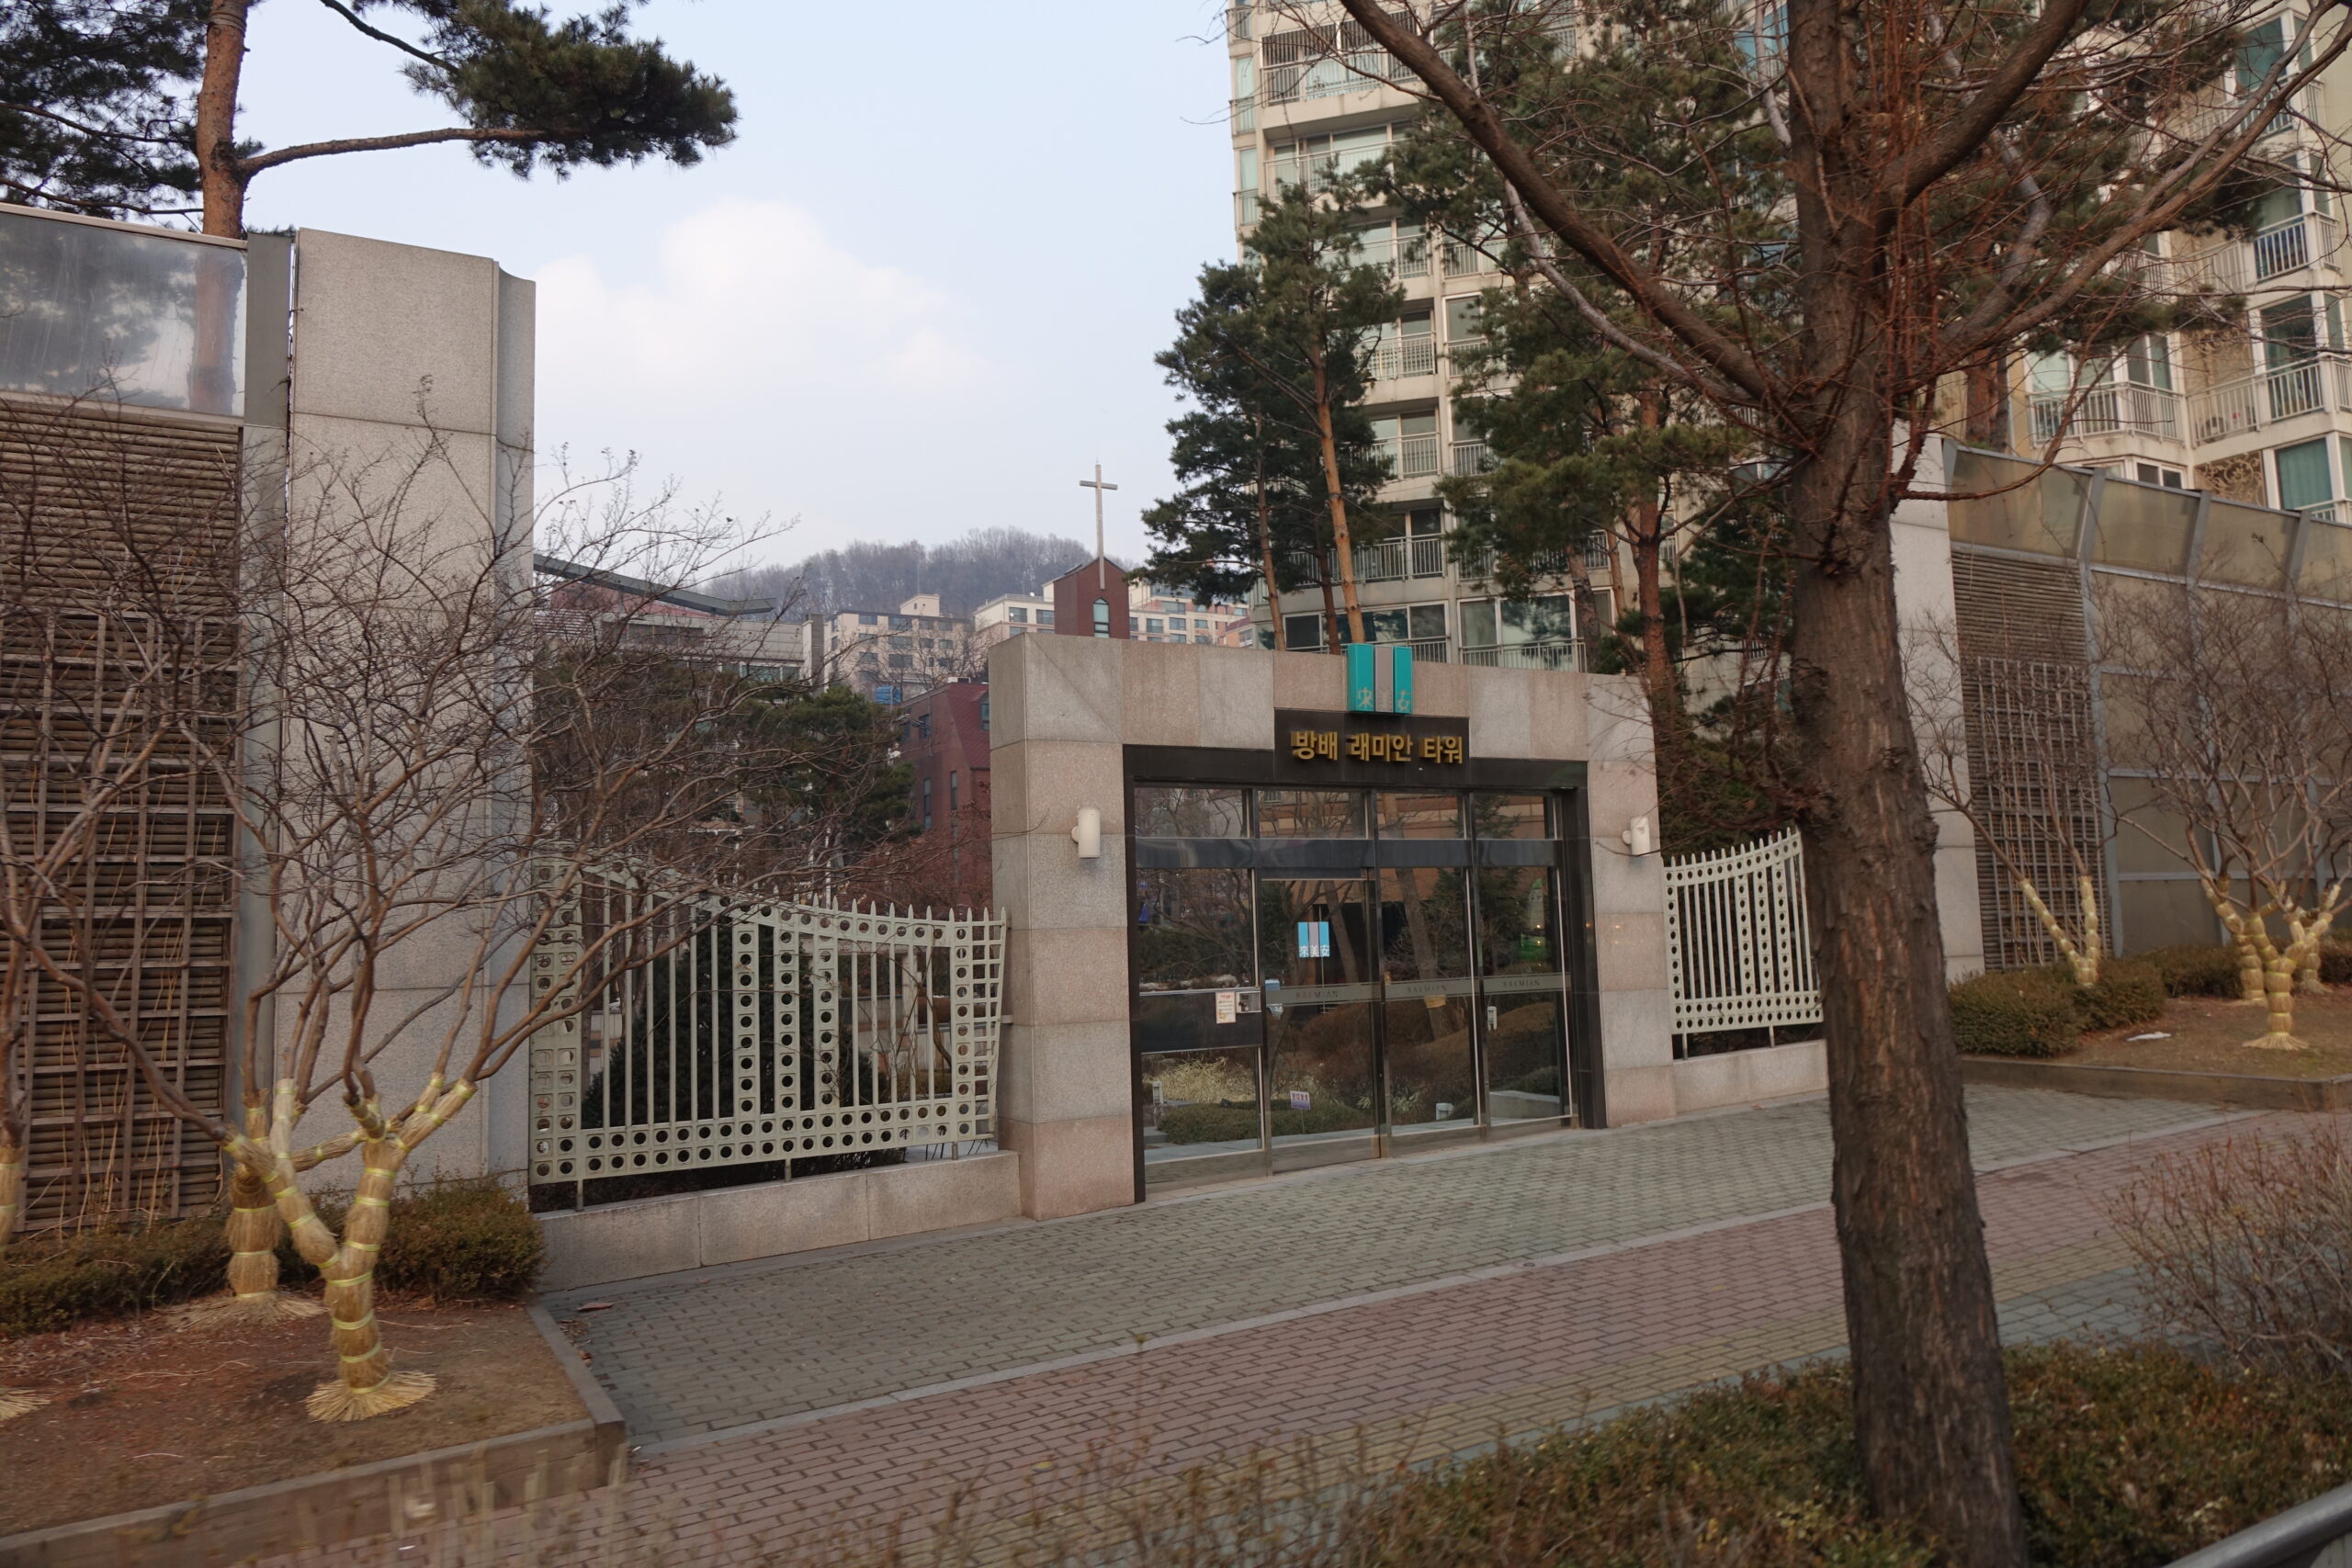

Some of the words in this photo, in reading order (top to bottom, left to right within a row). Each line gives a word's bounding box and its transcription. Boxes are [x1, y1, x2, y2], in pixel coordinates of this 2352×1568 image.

[1291, 730, 1338, 761] 방배
[1346, 733, 1413, 761] 래미안
[1419, 736, 1463, 764] 타워
[1299, 944, 1329, 957] 來美安
